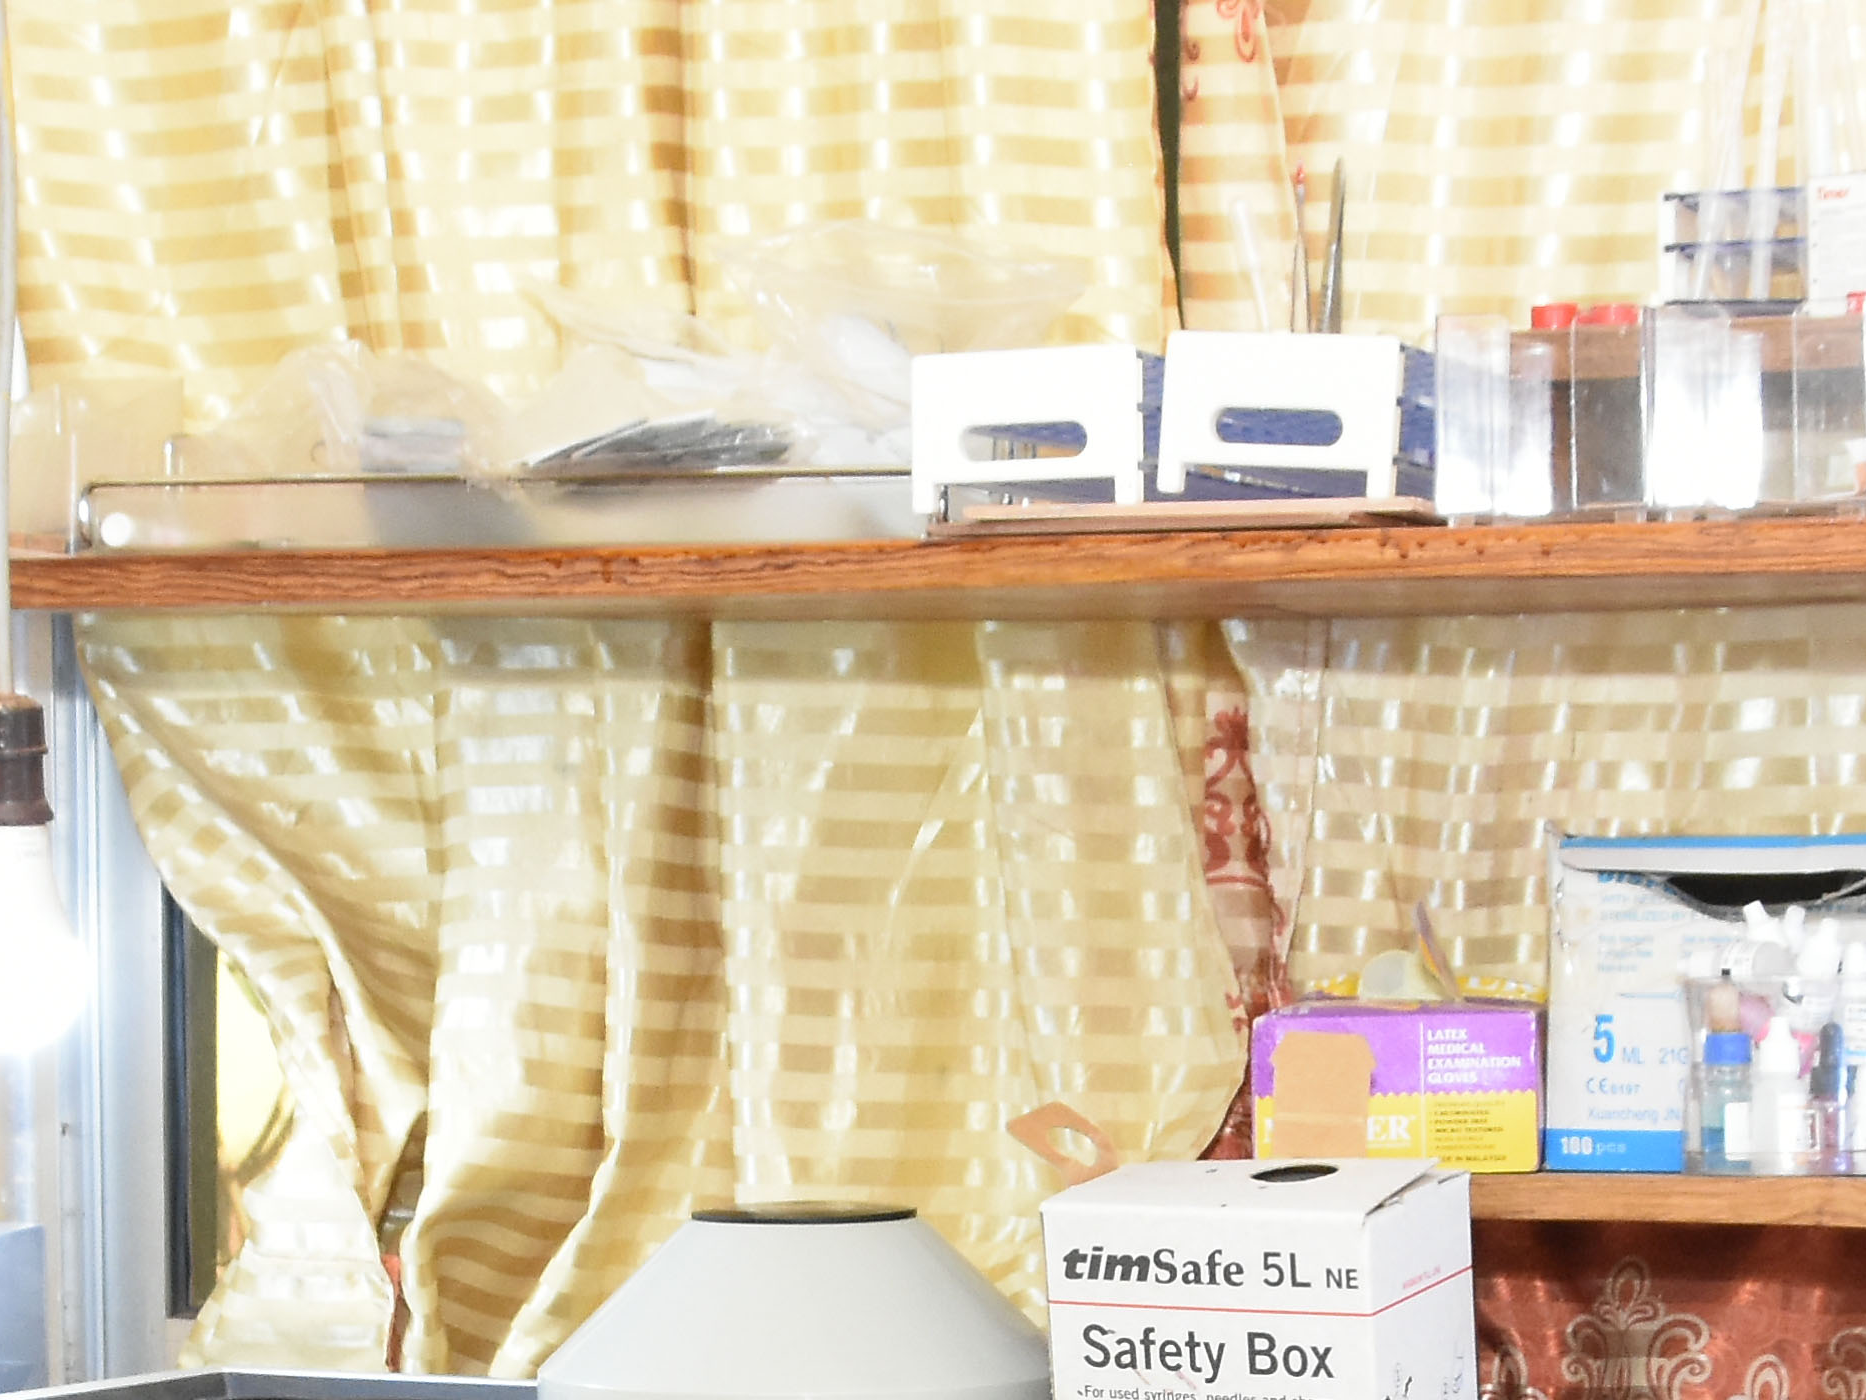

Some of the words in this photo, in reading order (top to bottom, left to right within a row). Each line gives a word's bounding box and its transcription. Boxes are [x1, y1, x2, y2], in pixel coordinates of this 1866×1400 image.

[1427, 1028, 1467, 1041] LATEX
[1593, 1014, 1615, 1064] 5
[1622, 1047, 1645, 1065] ML
[1427, 1043, 1486, 1056] MEDICAL
[1427, 1057, 1522, 1070] EXAMINATION
[1427, 1070, 1479, 1084] GLOVES
[1063, 1246, 1244, 1287] timSafe
[1263, 1251, 1312, 1288] 5L
[1326, 1268, 1359, 1290] NE
[1082, 1324, 1226, 1384] Safety
[1247, 1331, 1336, 1379] Box
[1084, 1385, 1105, 1399] For
[1109, 1387, 1139, 1400] used
